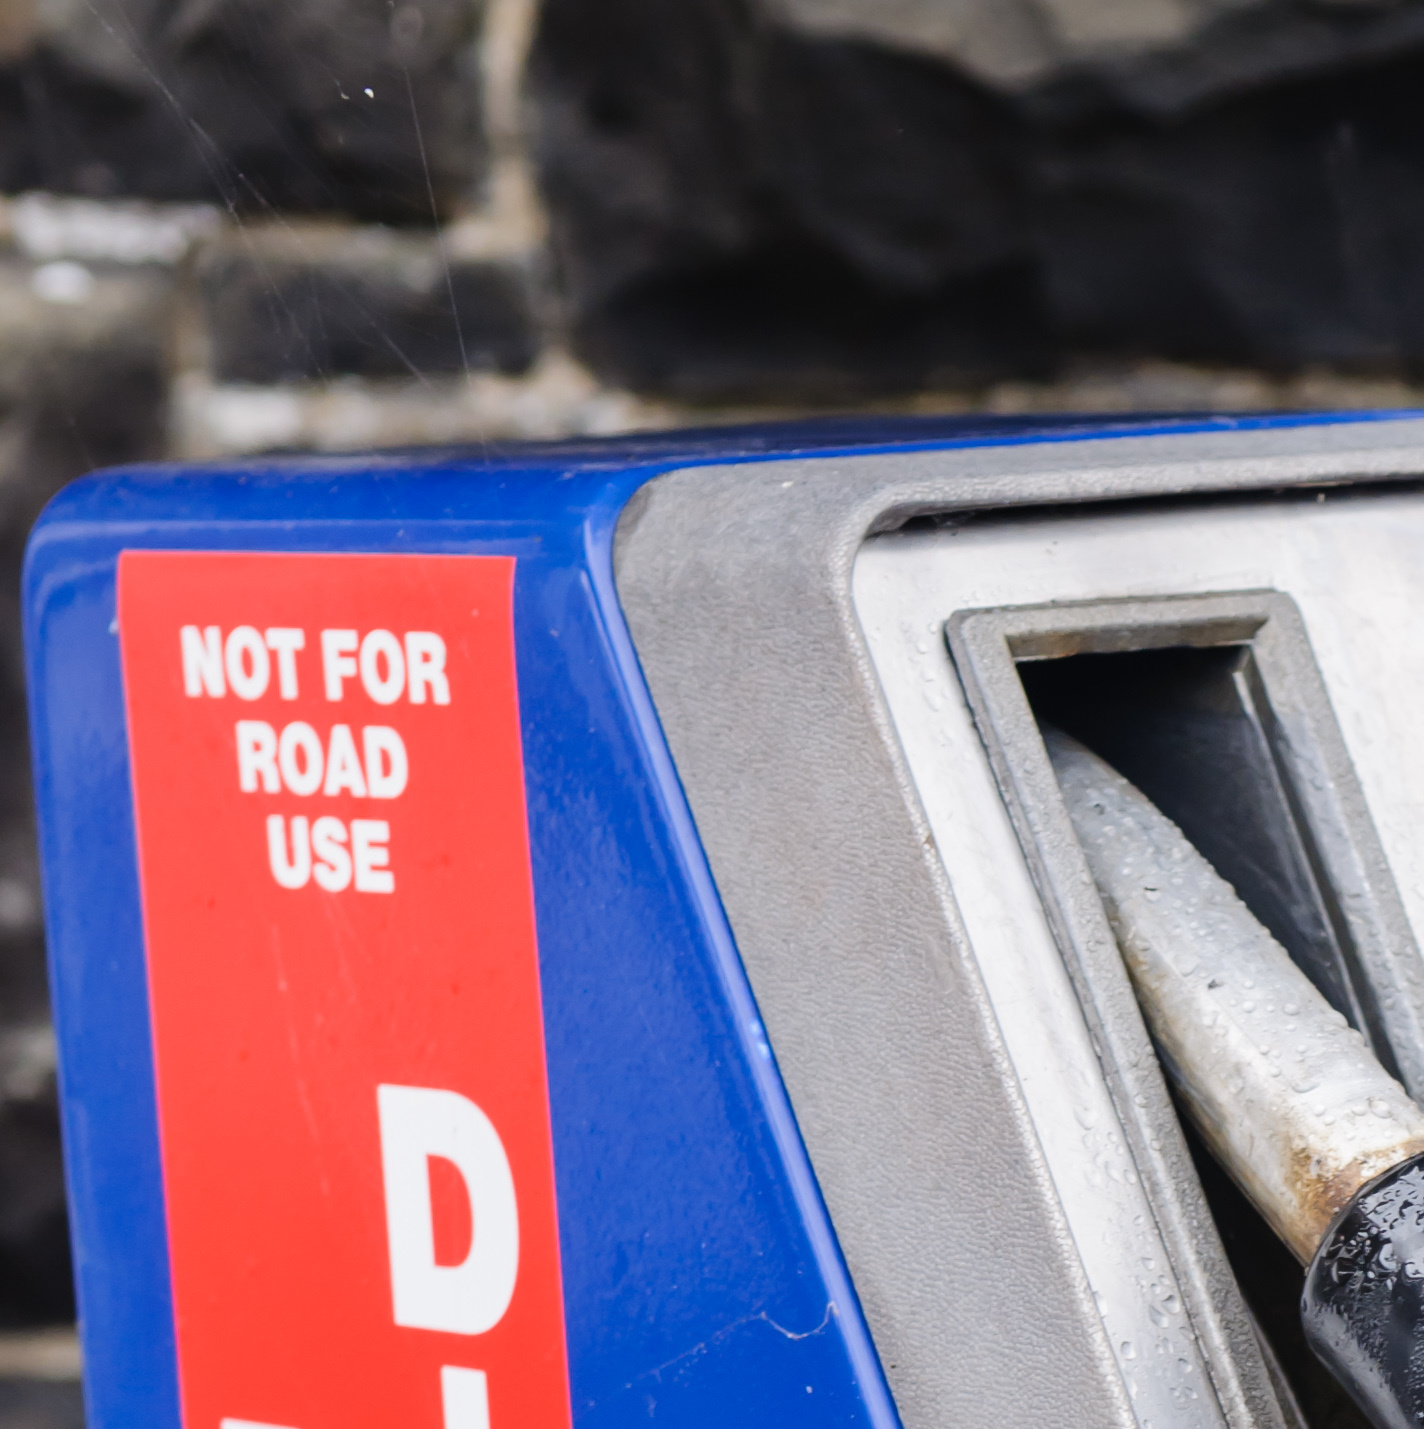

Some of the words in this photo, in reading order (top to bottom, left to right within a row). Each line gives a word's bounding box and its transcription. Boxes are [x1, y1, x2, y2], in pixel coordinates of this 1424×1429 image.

[180, 625, 305, 701] NOT
[321, 629, 451, 705] FOR
[235, 719, 408, 799] ROAD
[266, 814, 395, 894] USE
